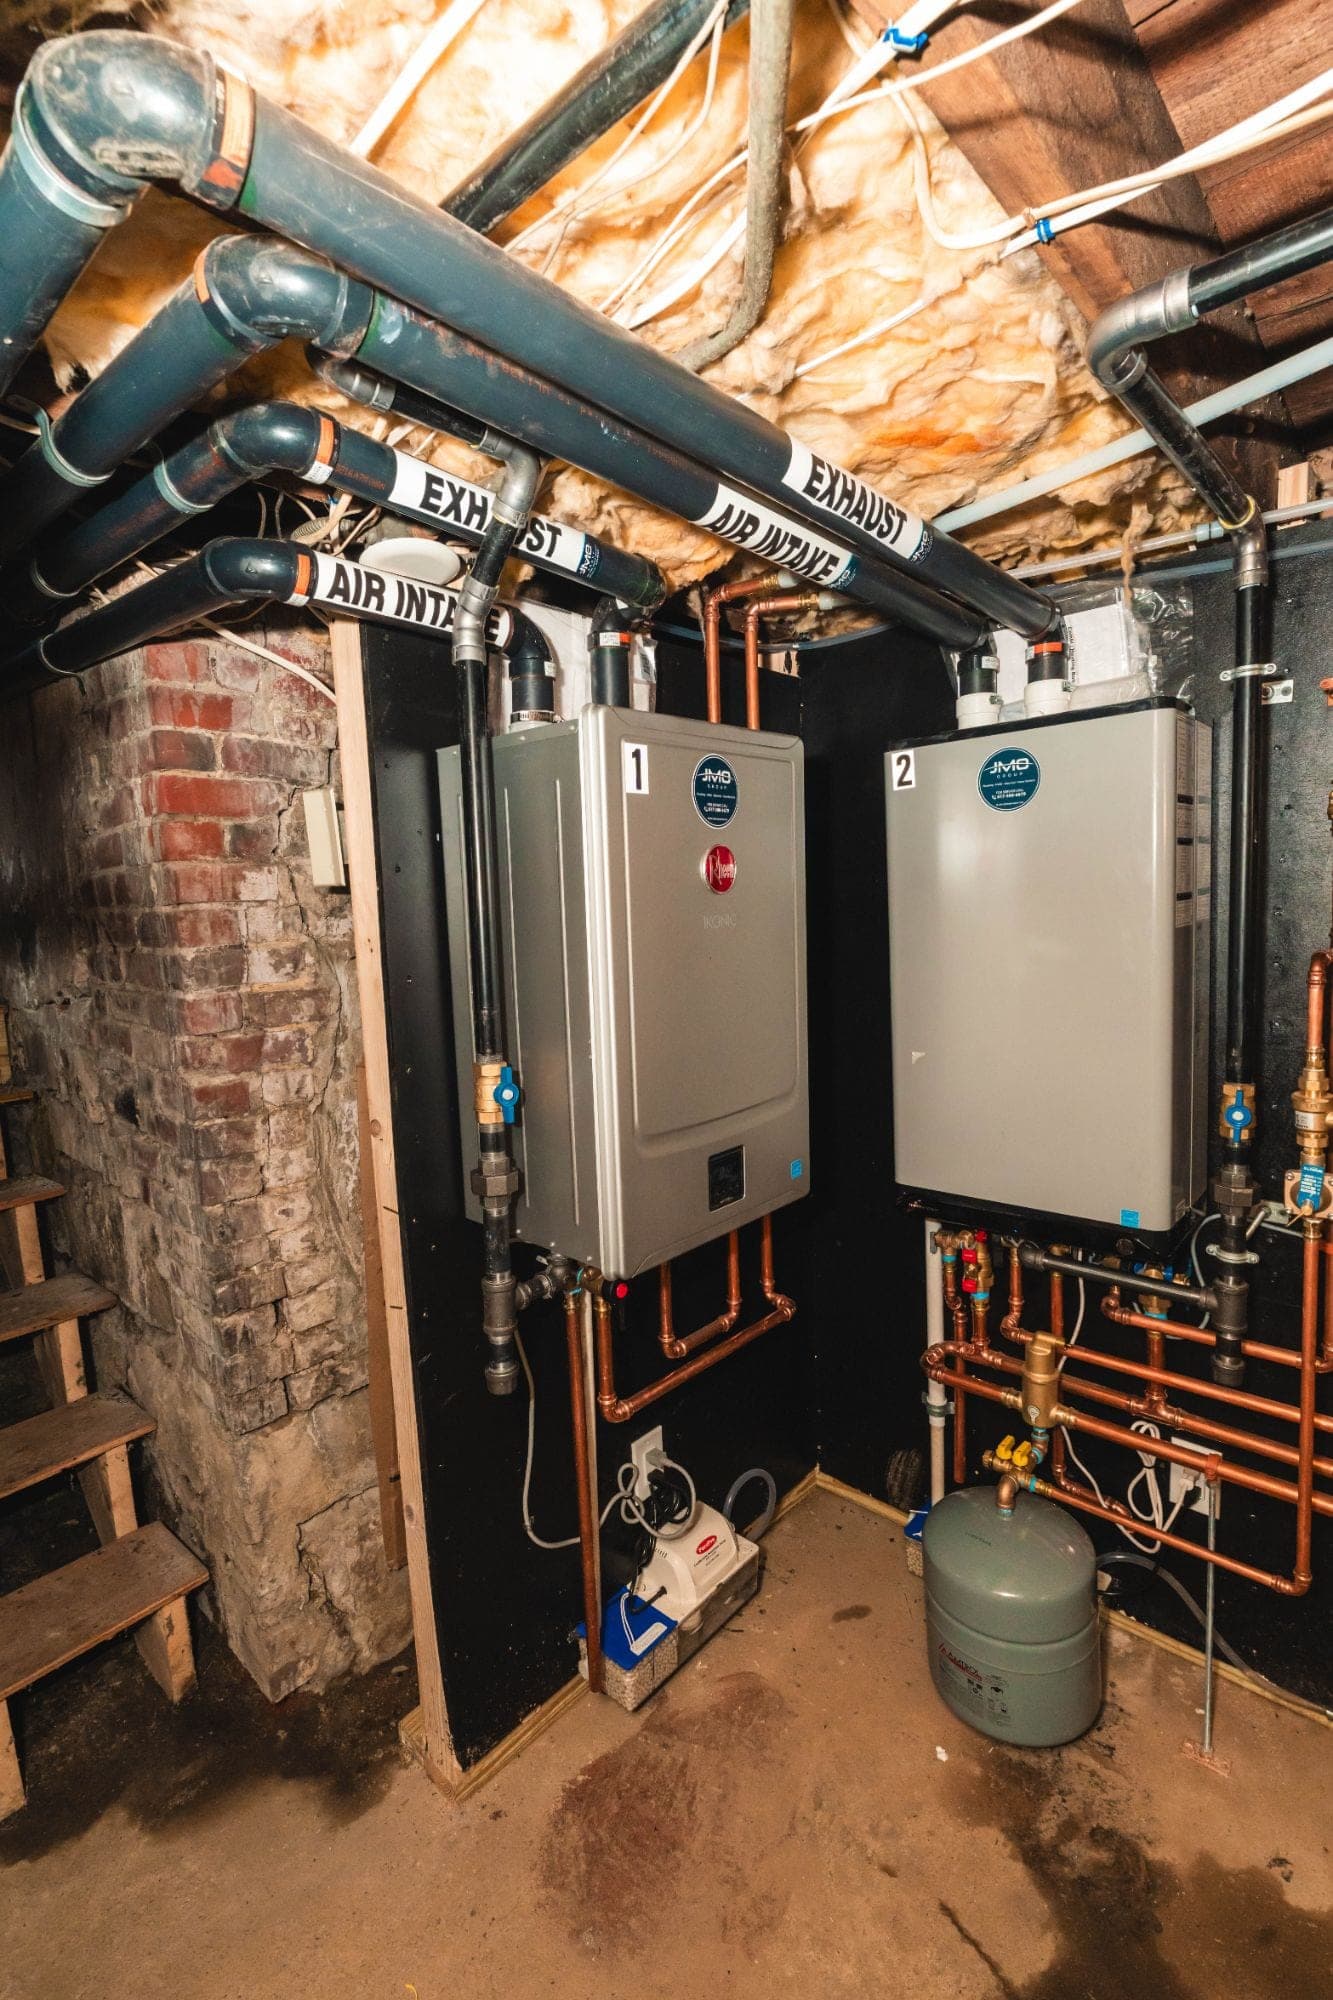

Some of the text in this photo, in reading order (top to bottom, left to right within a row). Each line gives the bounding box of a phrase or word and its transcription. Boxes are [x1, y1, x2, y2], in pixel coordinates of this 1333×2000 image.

[420, 471, 562, 558] EXHST
[802, 454, 908, 545] EXHAUST
[705, 504, 841, 582] AIR INTAKE
[326, 562, 500, 642] AIR INTAE
[631, 748, 642, 790] 1
[896, 754, 913, 787] 2
